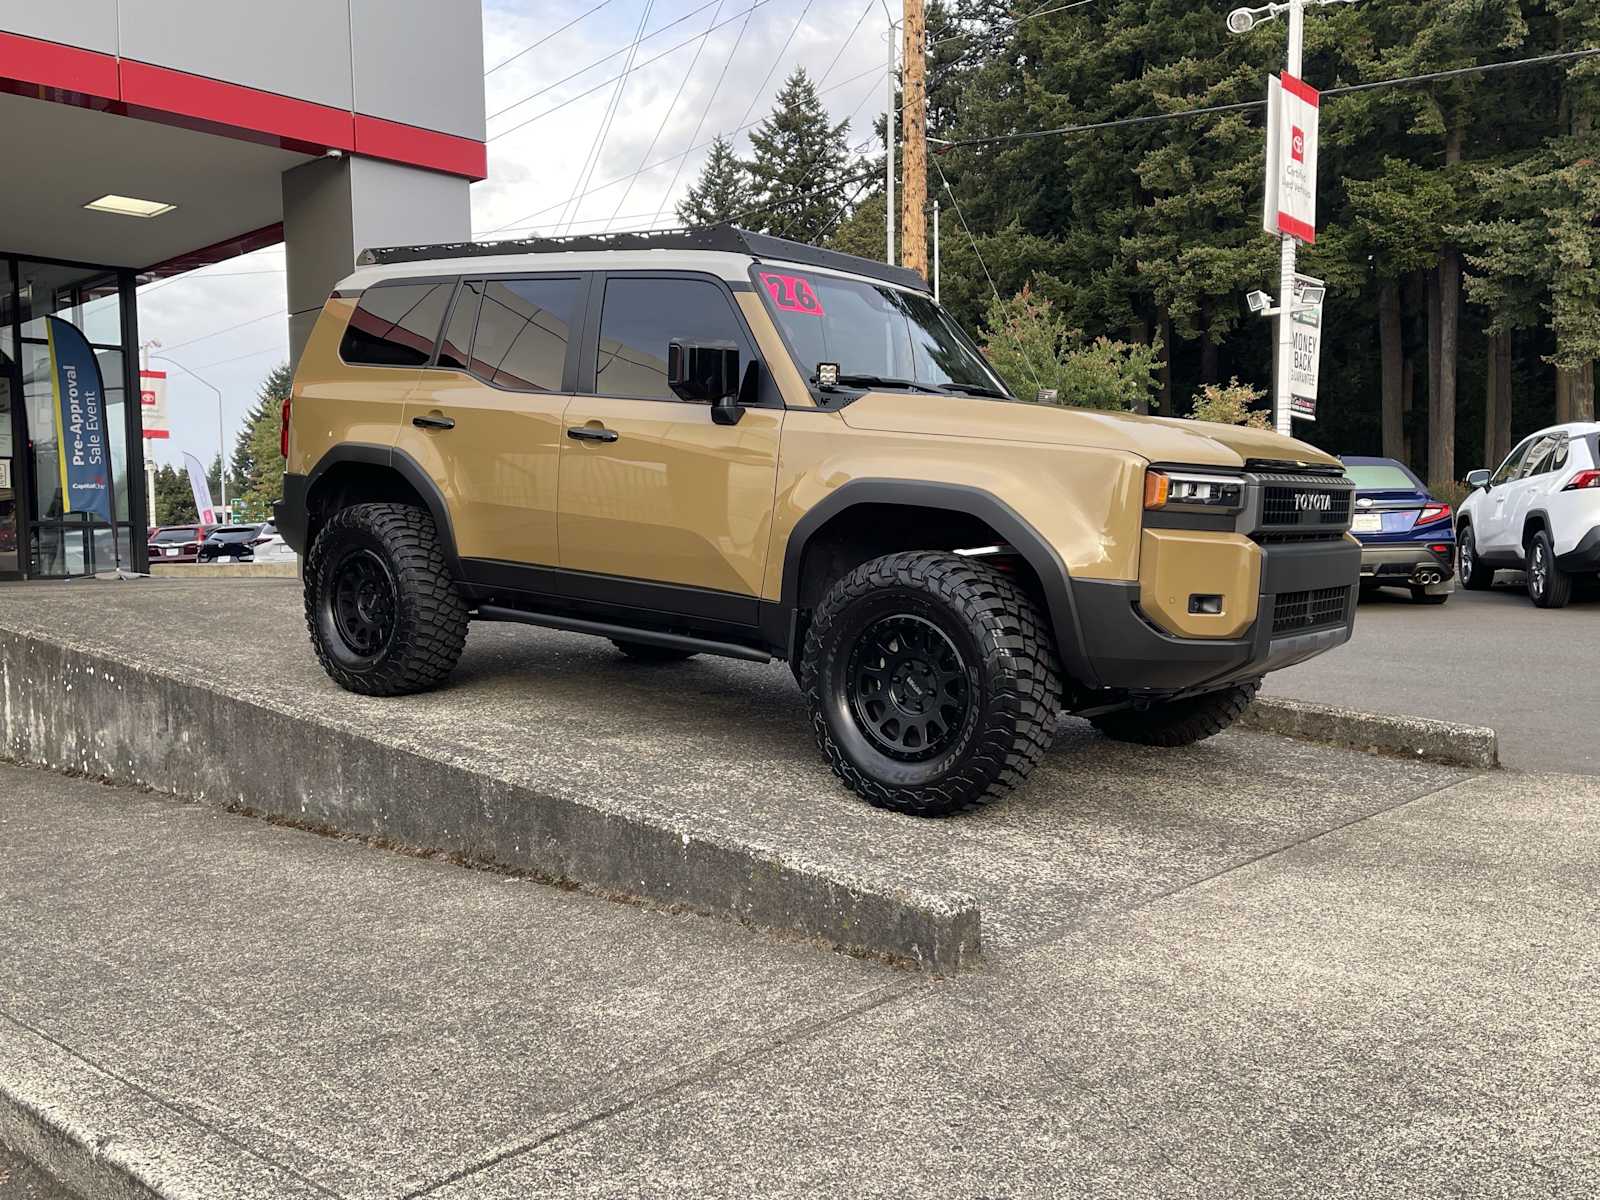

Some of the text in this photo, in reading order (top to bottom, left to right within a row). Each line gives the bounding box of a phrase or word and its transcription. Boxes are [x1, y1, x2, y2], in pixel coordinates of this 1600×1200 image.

[766, 276, 817, 309] 26
[1292, 331, 1317, 354] MONEY
[1294, 351, 1313, 373] BACK
[63, 365, 85, 466] Pre-Approval
[84, 391, 102, 465] Sale Event
[1294, 493, 1331, 510] TOYOTA
